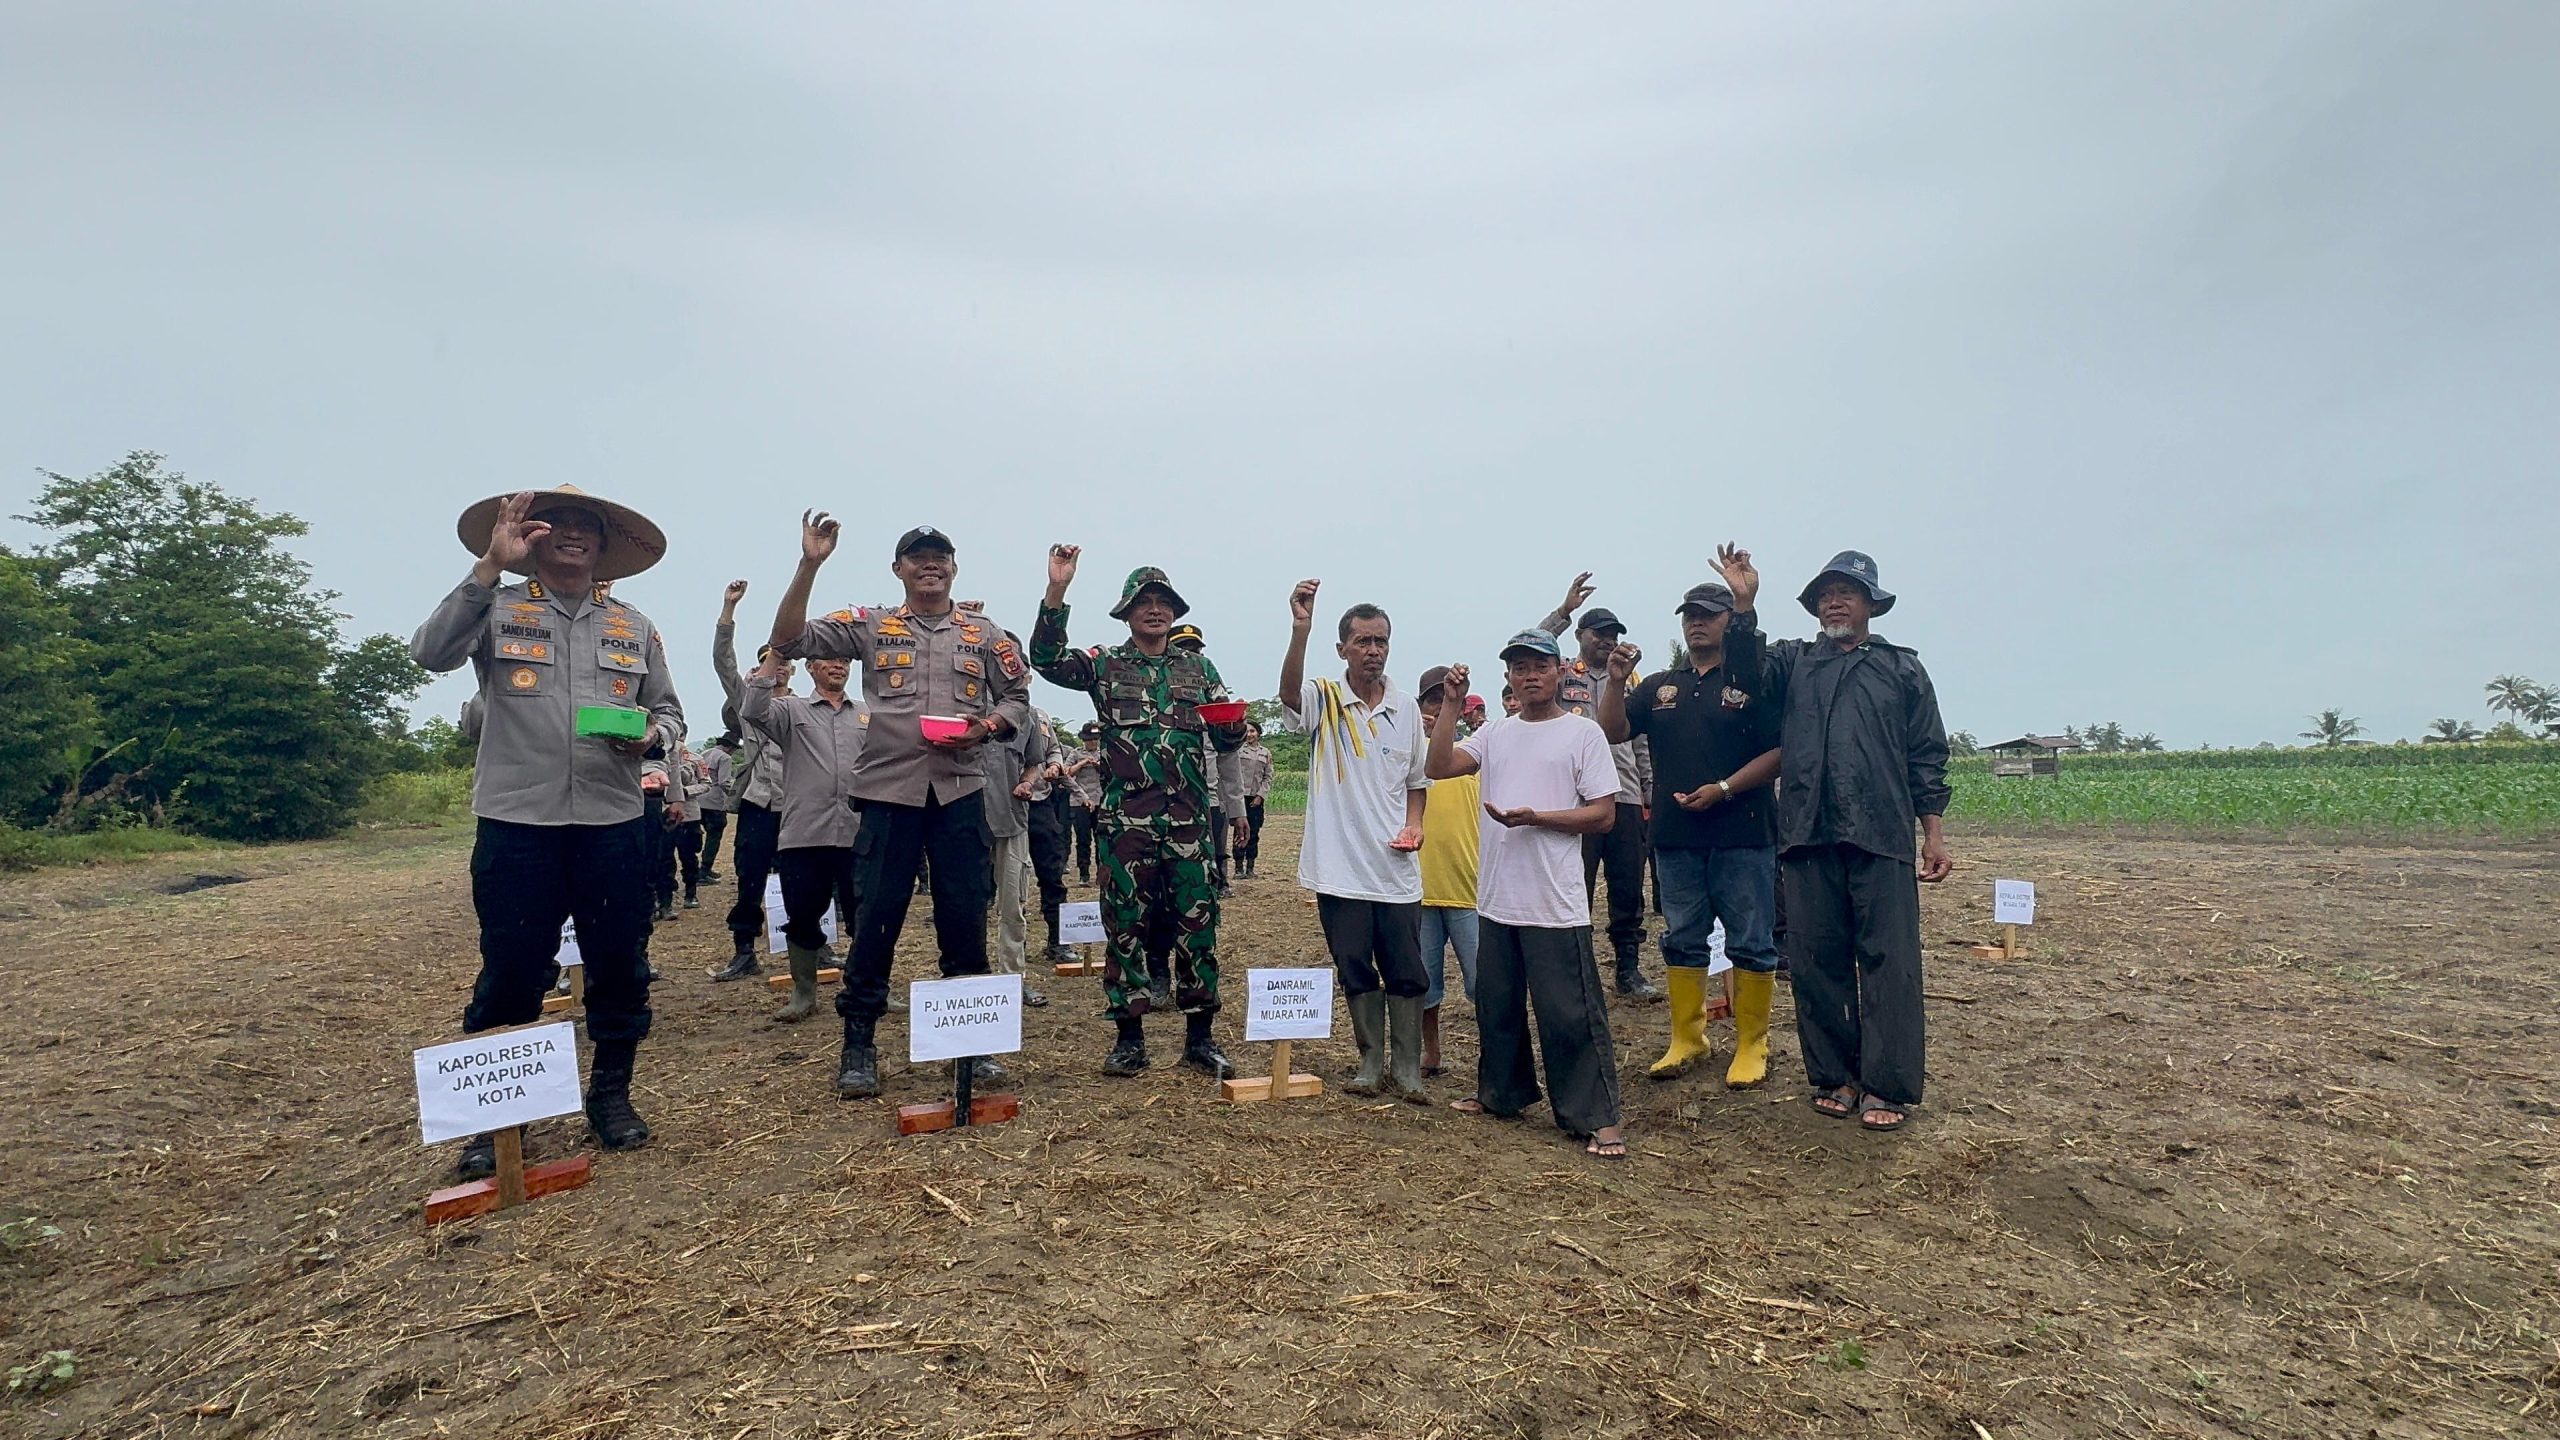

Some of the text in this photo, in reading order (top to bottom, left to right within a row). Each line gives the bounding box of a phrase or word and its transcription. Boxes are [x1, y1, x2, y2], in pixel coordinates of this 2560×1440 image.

[501, 623, 552, 640] SANDI SULTAN
[600, 638, 640, 652] POLRI
[957, 644, 986, 656] POLRI
[1077, 914, 1099, 922] KEPALA
[1267, 980, 1316, 991] DANRAMIL
[924, 994, 1009, 1013] PJ. WALIKOTA
[1272, 994, 1309, 1006] DISTRIK
[934, 1011, 999, 1029] JAYAPURA
[1260, 1008, 1319, 1021] MUARA TAMI
[438, 1039, 556, 1075] KAPOLRESTA
[452, 1061, 546, 1092] JAYAPURA
[477, 1085, 527, 1107] KOTA
